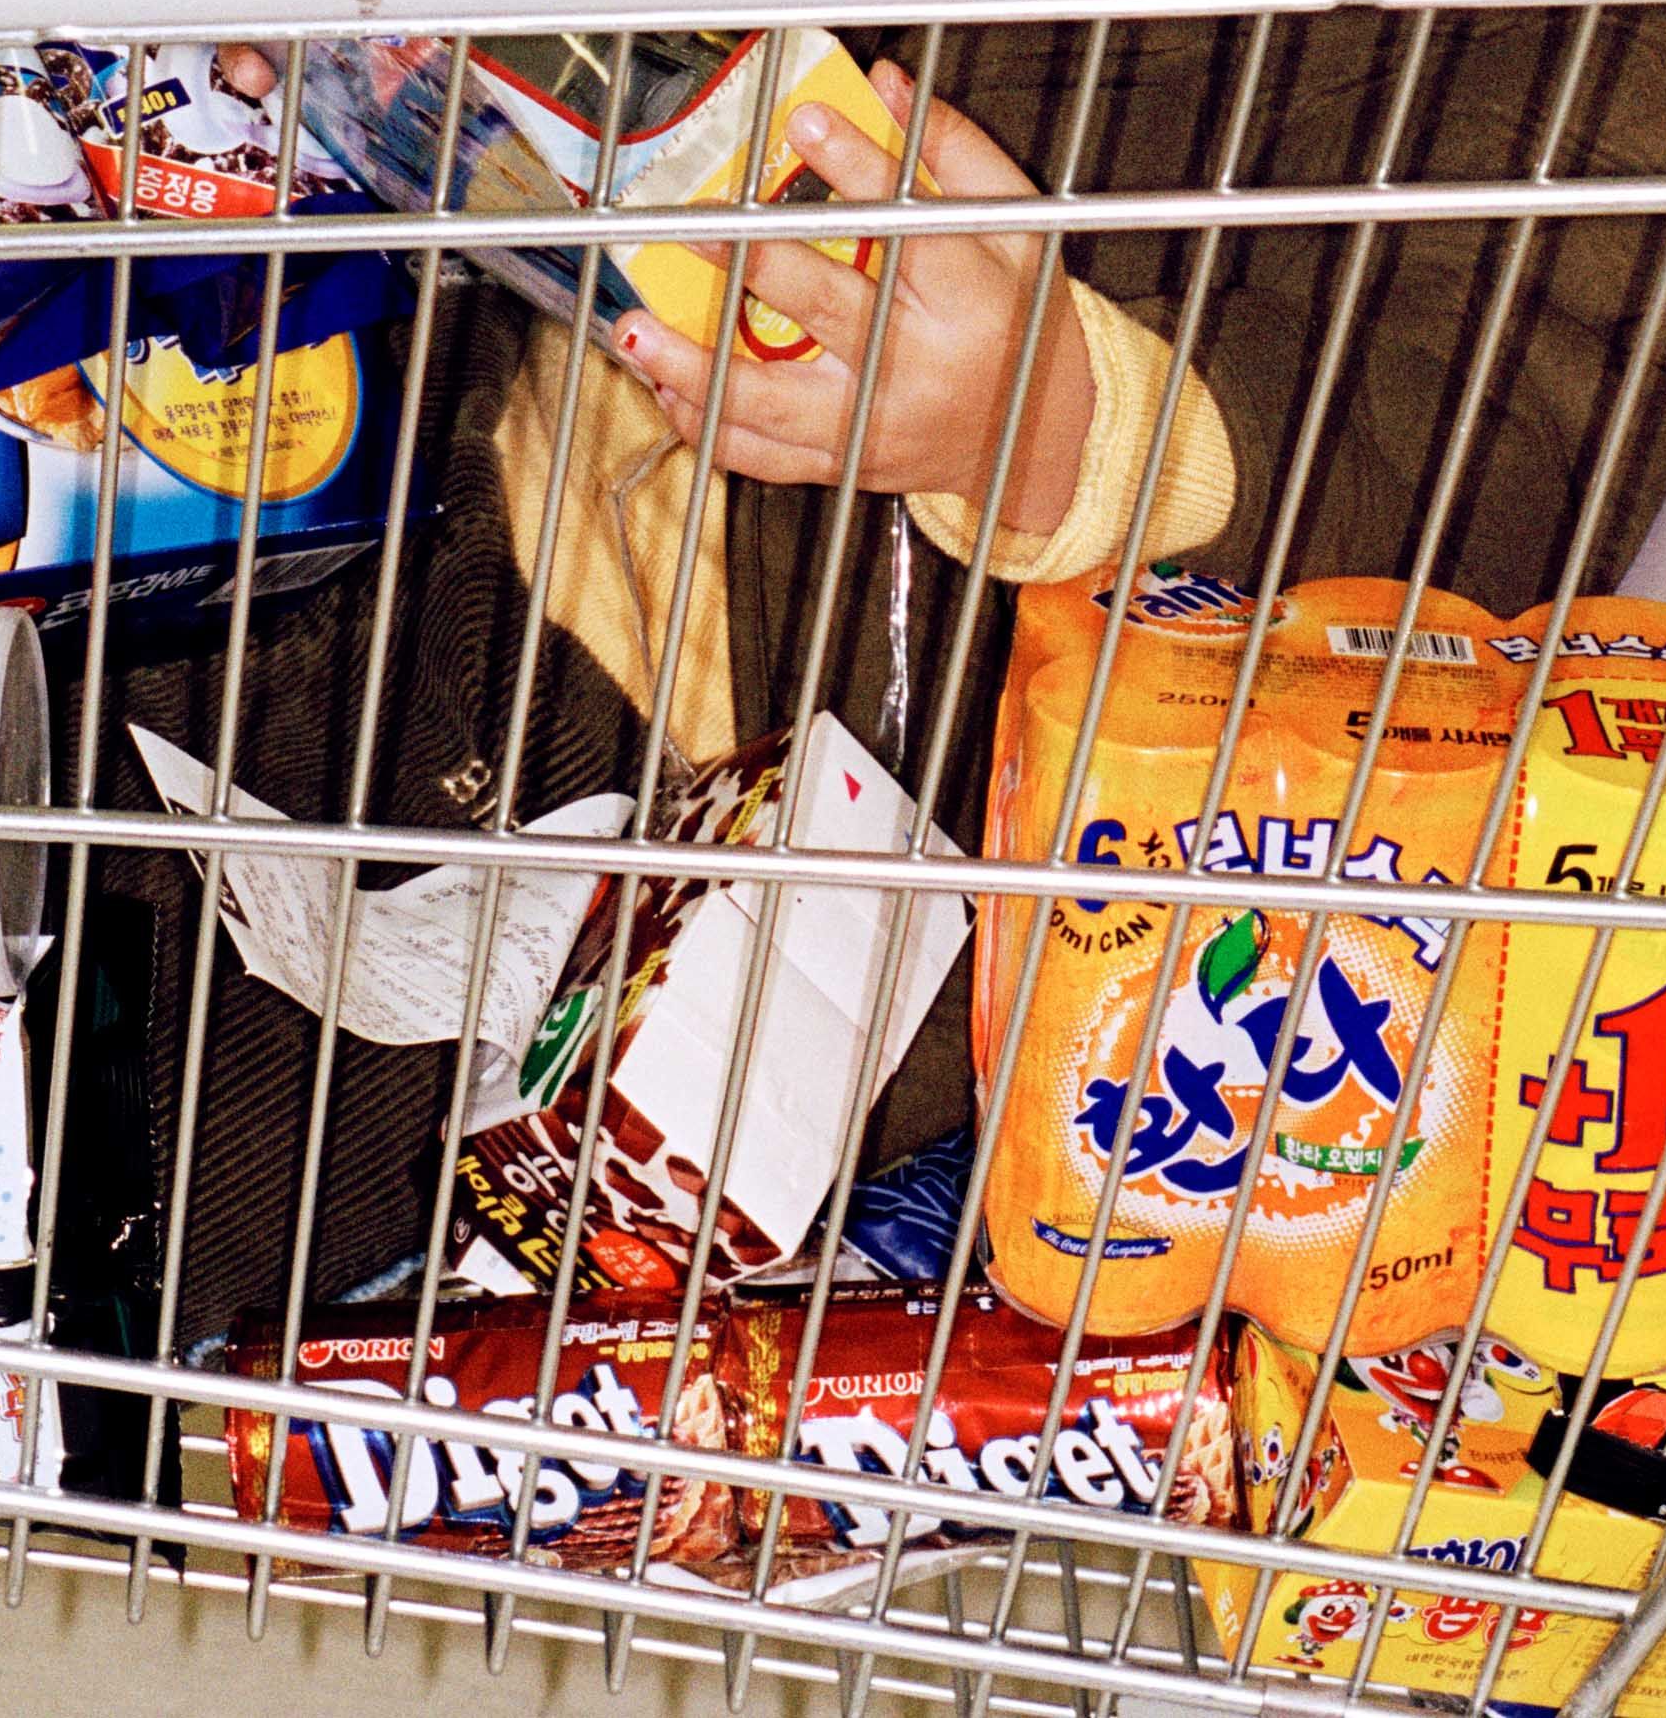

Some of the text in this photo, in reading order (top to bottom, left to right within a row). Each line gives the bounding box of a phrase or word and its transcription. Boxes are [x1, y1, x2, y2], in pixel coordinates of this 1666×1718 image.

[135, 165, 220, 217] 증정용
[1076, 818, 1131, 916] 6
[1098, 916, 1154, 954] CAN
[1073, 954, 1404, 1194] 환타
[1361, 1246, 1454, 1293] 50ml
[336, 1336, 446, 1361] ORION
[825, 1371, 927, 1399] ORION
